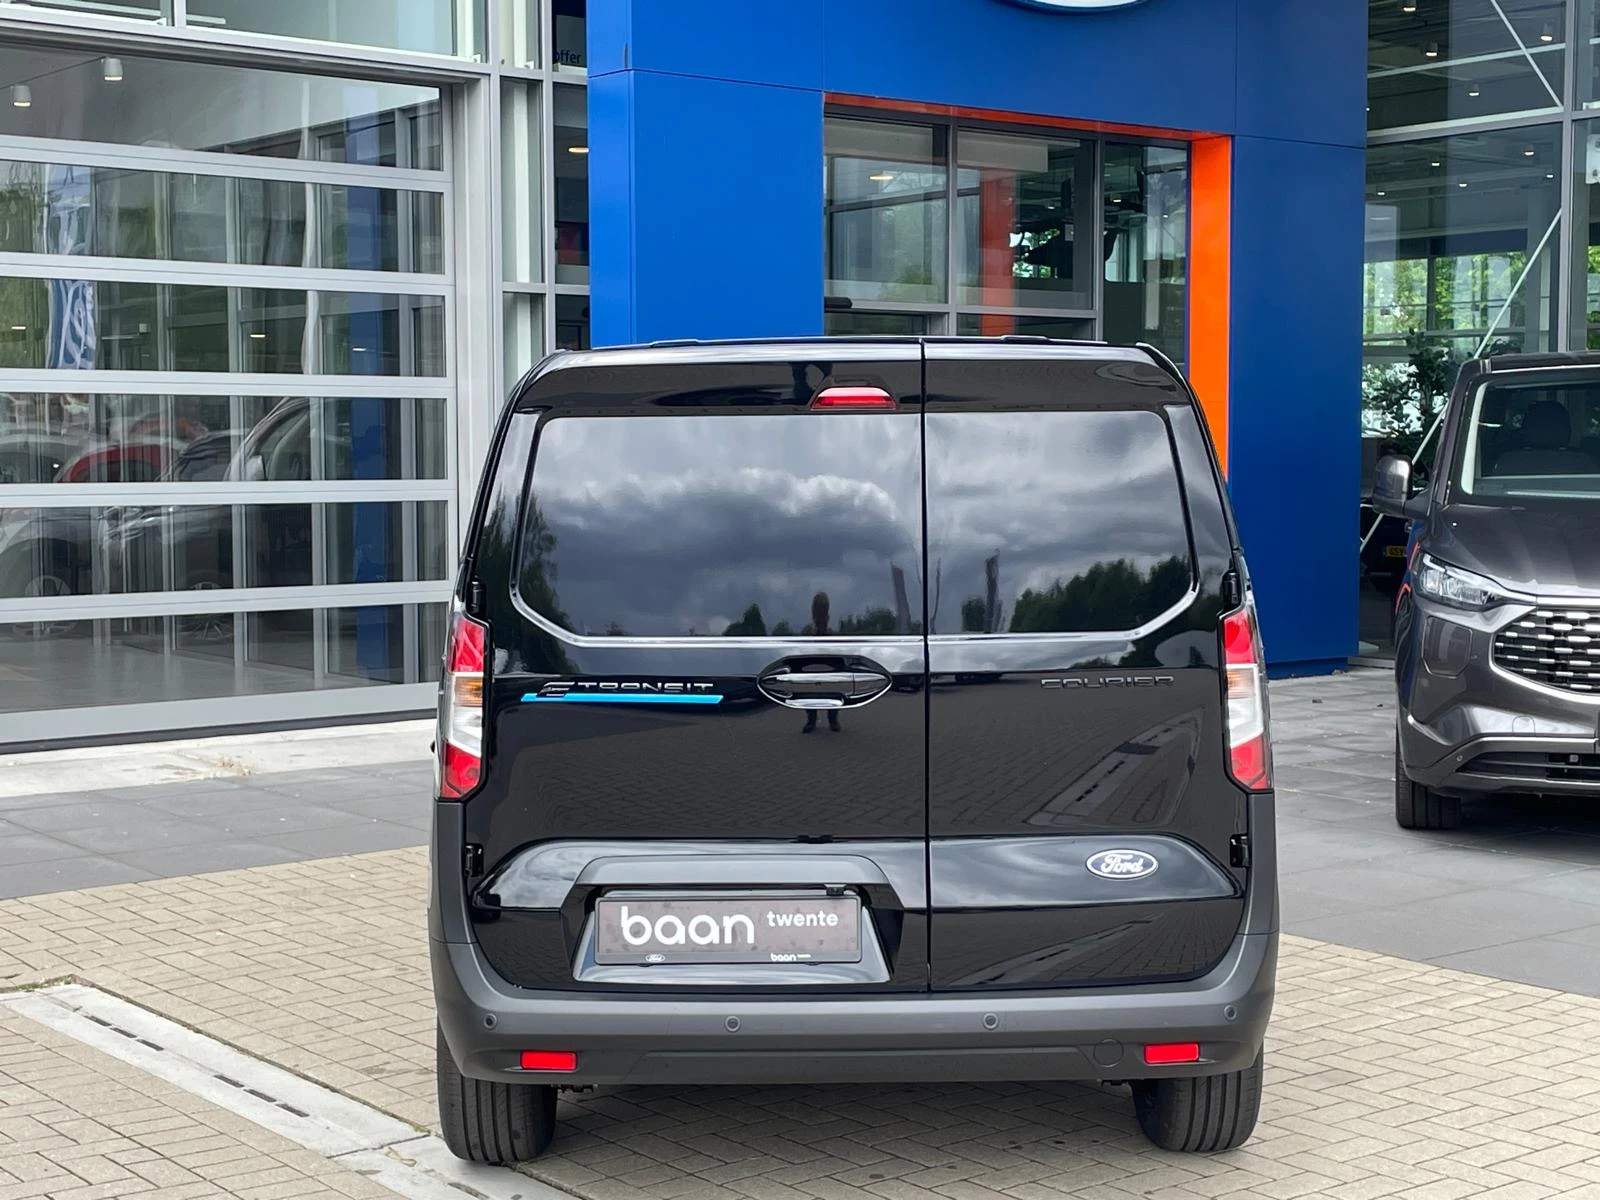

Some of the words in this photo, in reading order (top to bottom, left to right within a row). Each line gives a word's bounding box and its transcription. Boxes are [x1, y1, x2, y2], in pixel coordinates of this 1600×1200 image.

[1041, 676, 1174, 689] COURIER
[1100, 853, 1144, 873] Ford
[620, 905, 755, 946] baan
[766, 910, 839, 927] twente
[770, 952, 797, 962] baan
